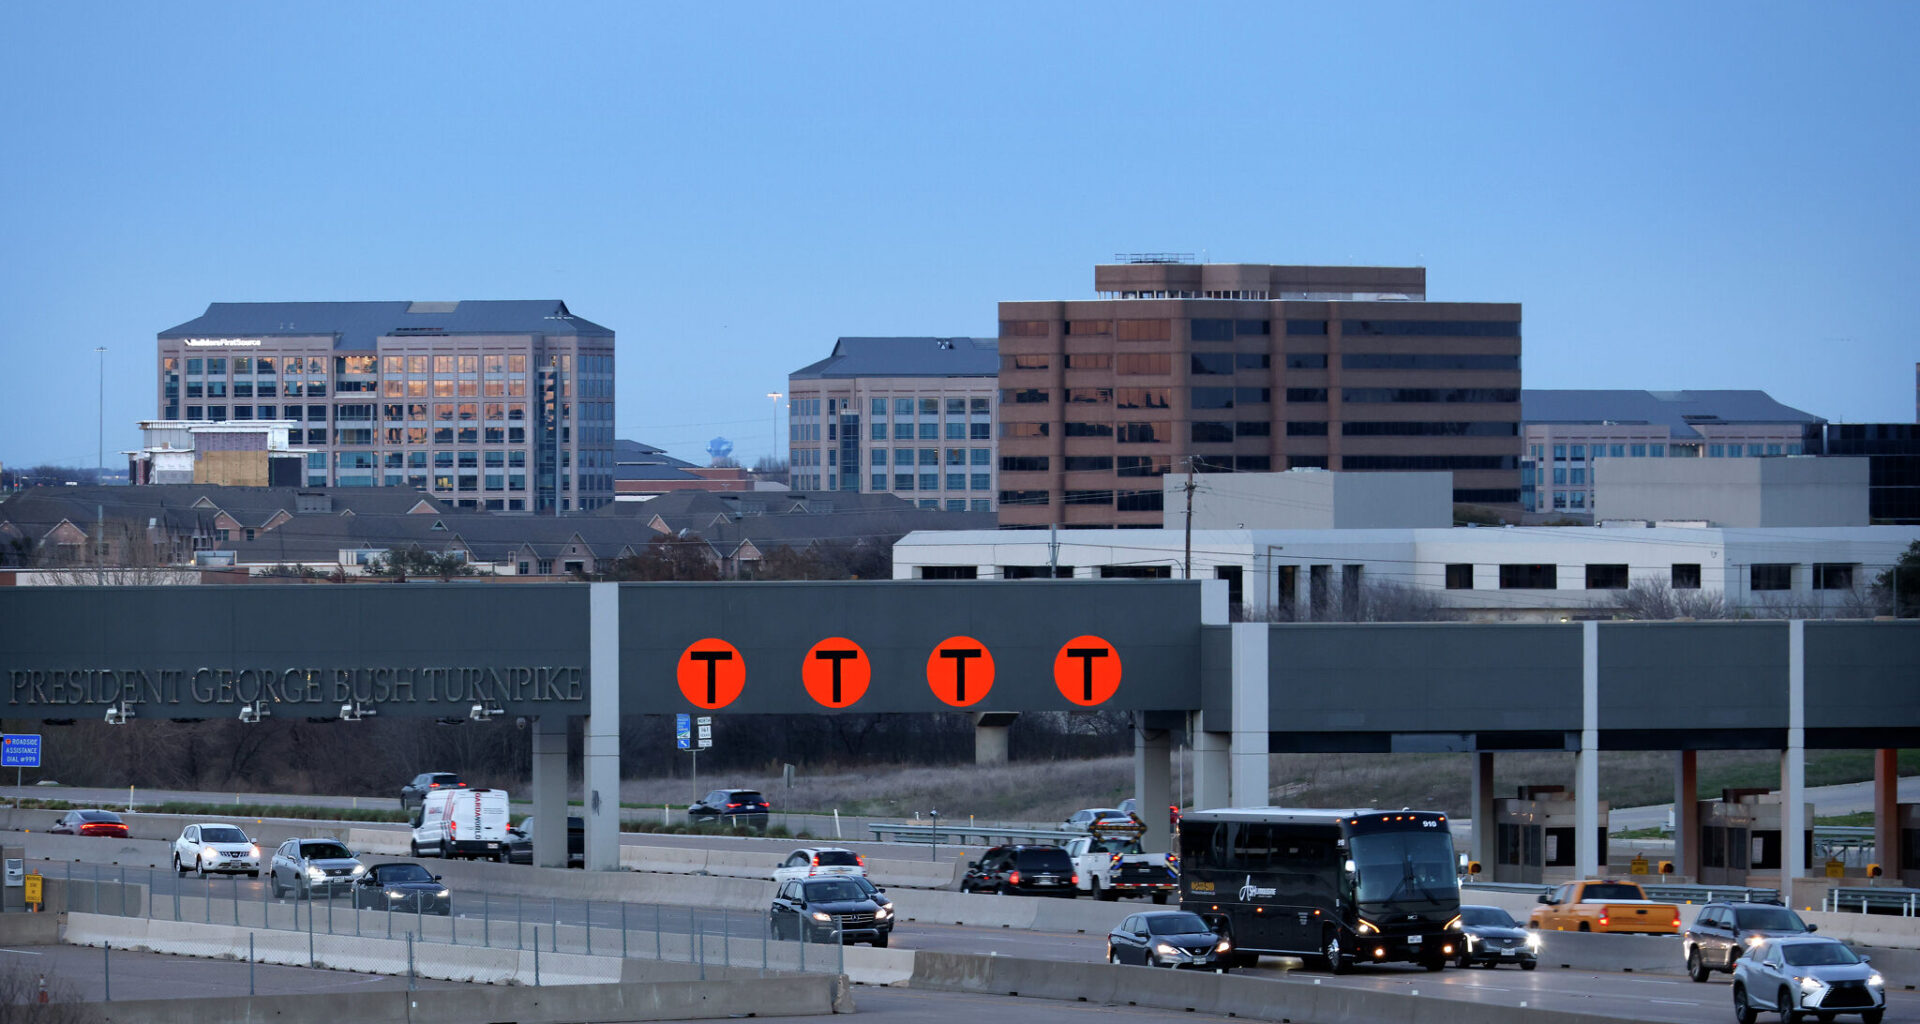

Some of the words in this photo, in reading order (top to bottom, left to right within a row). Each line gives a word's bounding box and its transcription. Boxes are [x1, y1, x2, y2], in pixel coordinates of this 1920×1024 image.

[8, 668, 182, 704] PRESIDENT
[191, 667, 324, 703] GEORGE
[332, 667, 417, 703] BUSH
[423, 666, 584, 702] TURNPIKE
[690, 651, 732, 703] T
[816, 650, 857, 702] T
[940, 649, 981, 701] T
[1067, 648, 1108, 700] T
